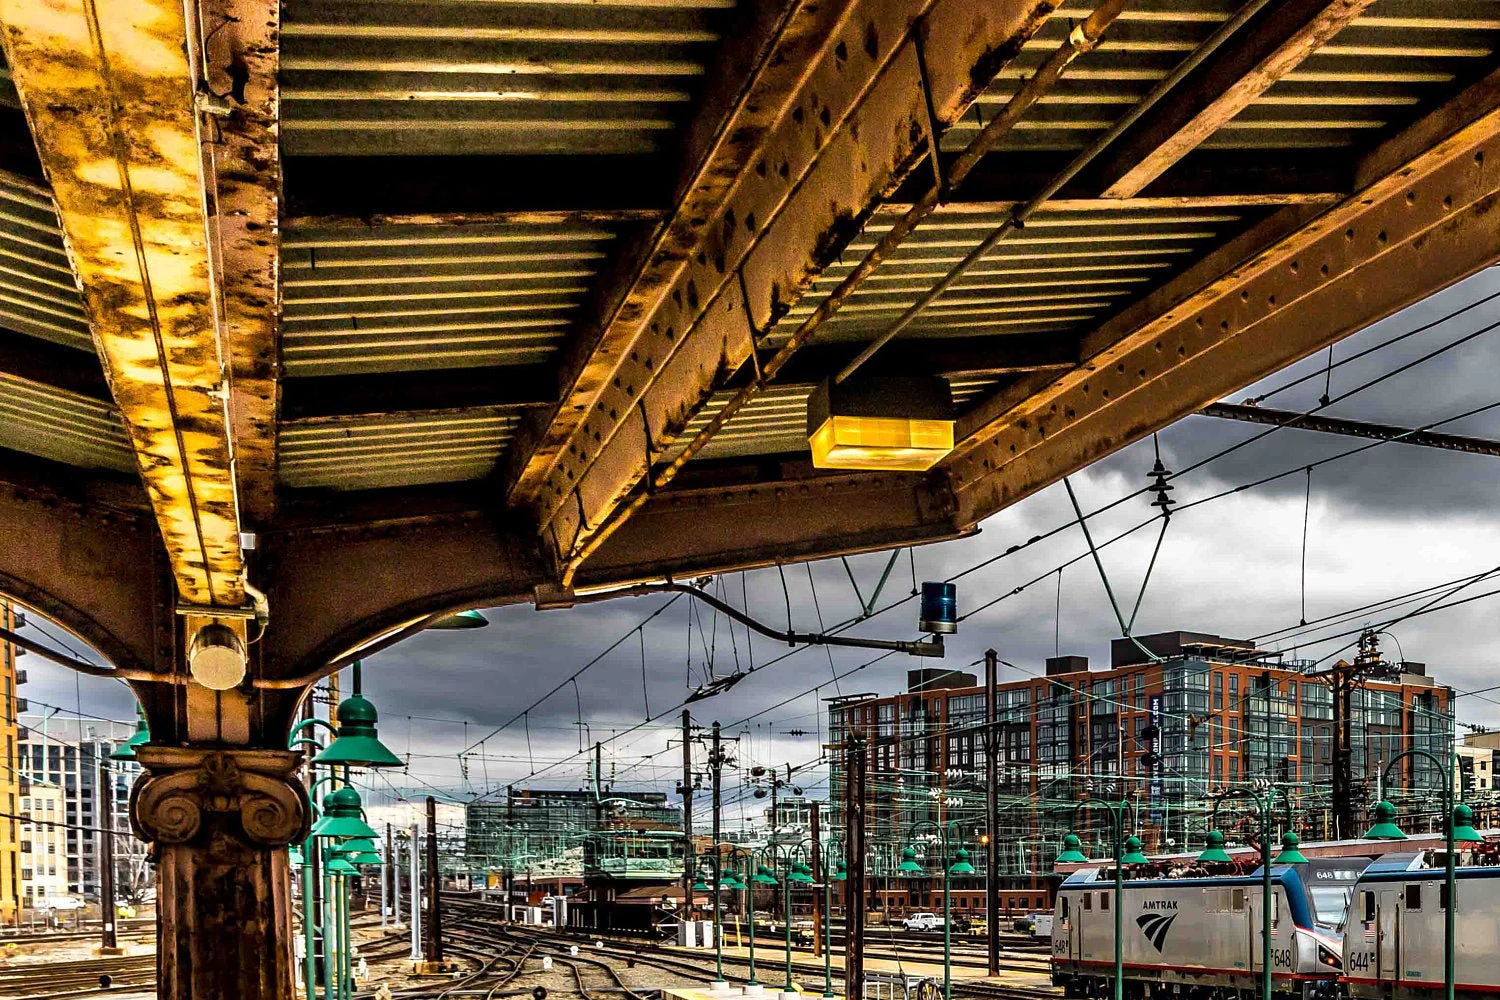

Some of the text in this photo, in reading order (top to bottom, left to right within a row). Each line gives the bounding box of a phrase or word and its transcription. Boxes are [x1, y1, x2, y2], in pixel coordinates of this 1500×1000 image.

[1316, 871, 1334, 879] 648
[1142, 900, 1178, 910] AMTRAK
[1274, 948, 1291, 968] 648
[1349, 951, 1369, 972] 644
